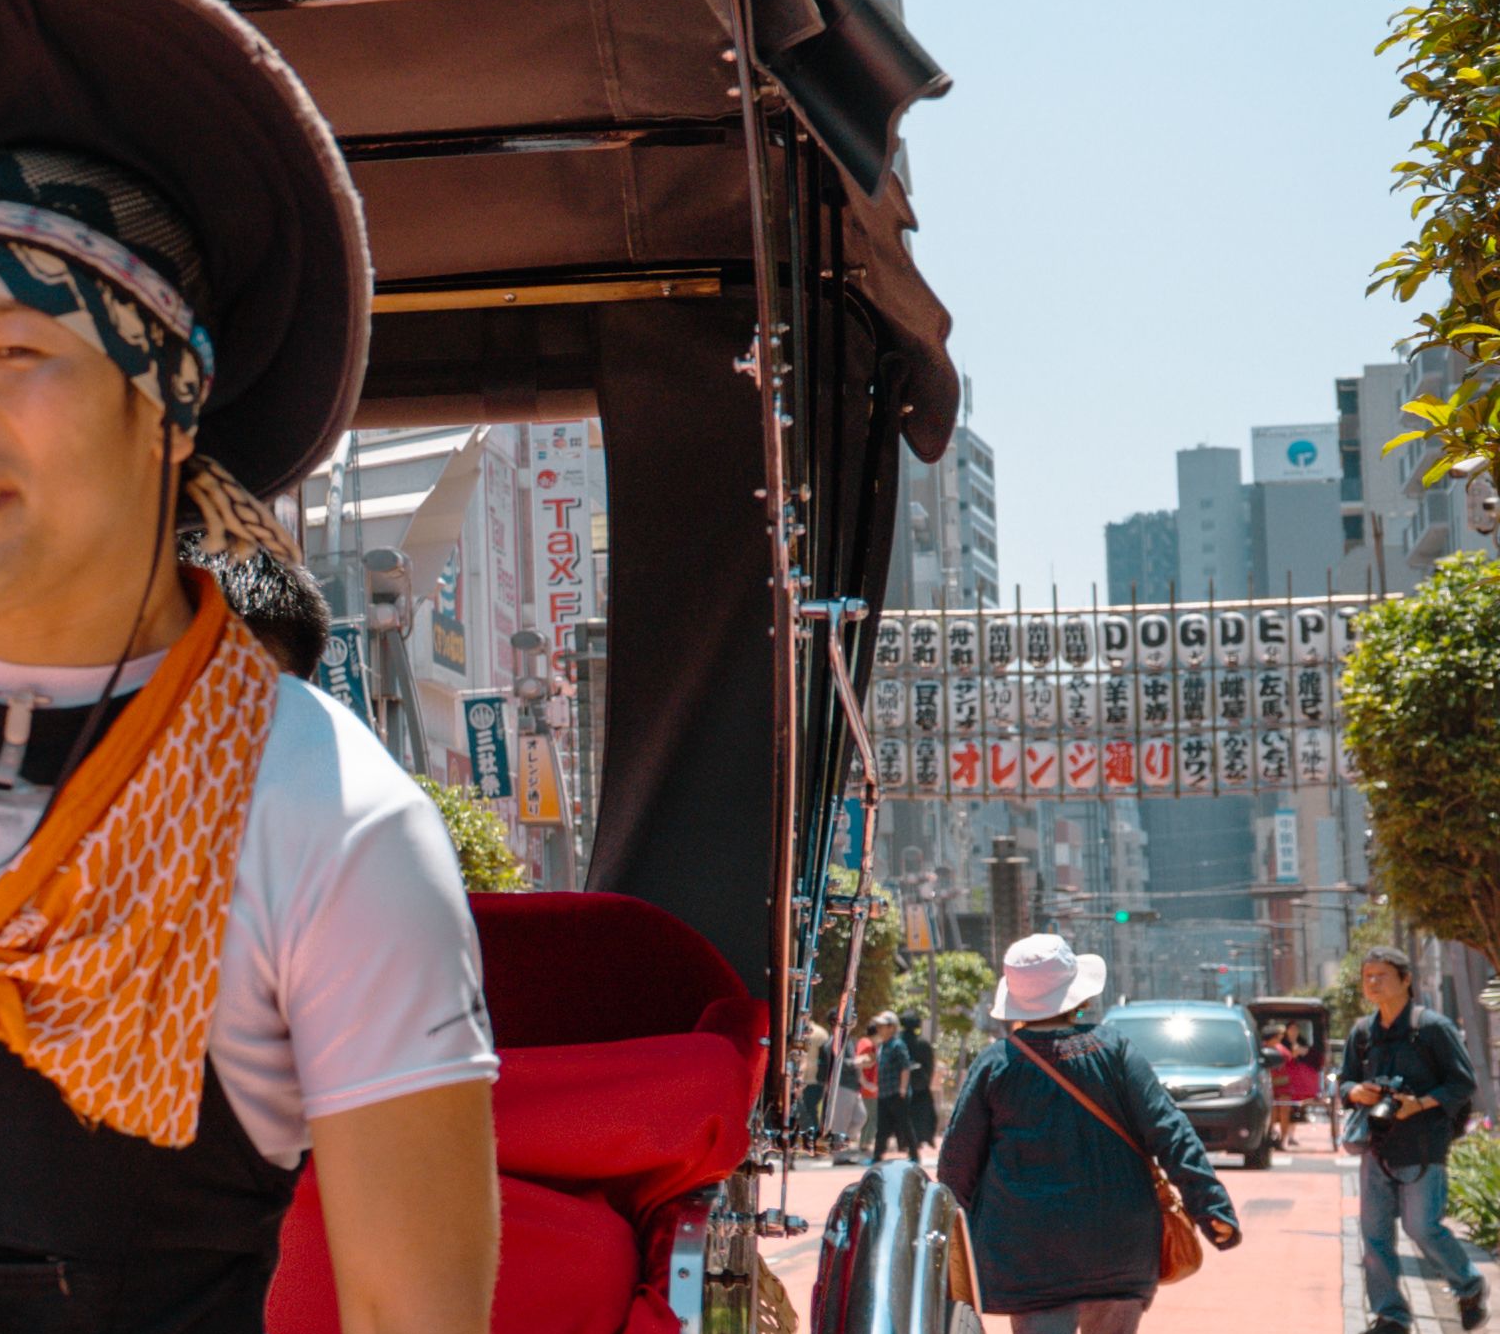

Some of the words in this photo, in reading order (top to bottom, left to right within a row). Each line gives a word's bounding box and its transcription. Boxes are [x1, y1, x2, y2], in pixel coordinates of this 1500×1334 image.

[541, 497, 581, 586] Tax
[476, 729, 501, 796] 三社祭
[526, 740, 540, 817] オレンジ通り
[952, 740, 1173, 786] オレンジ通り
